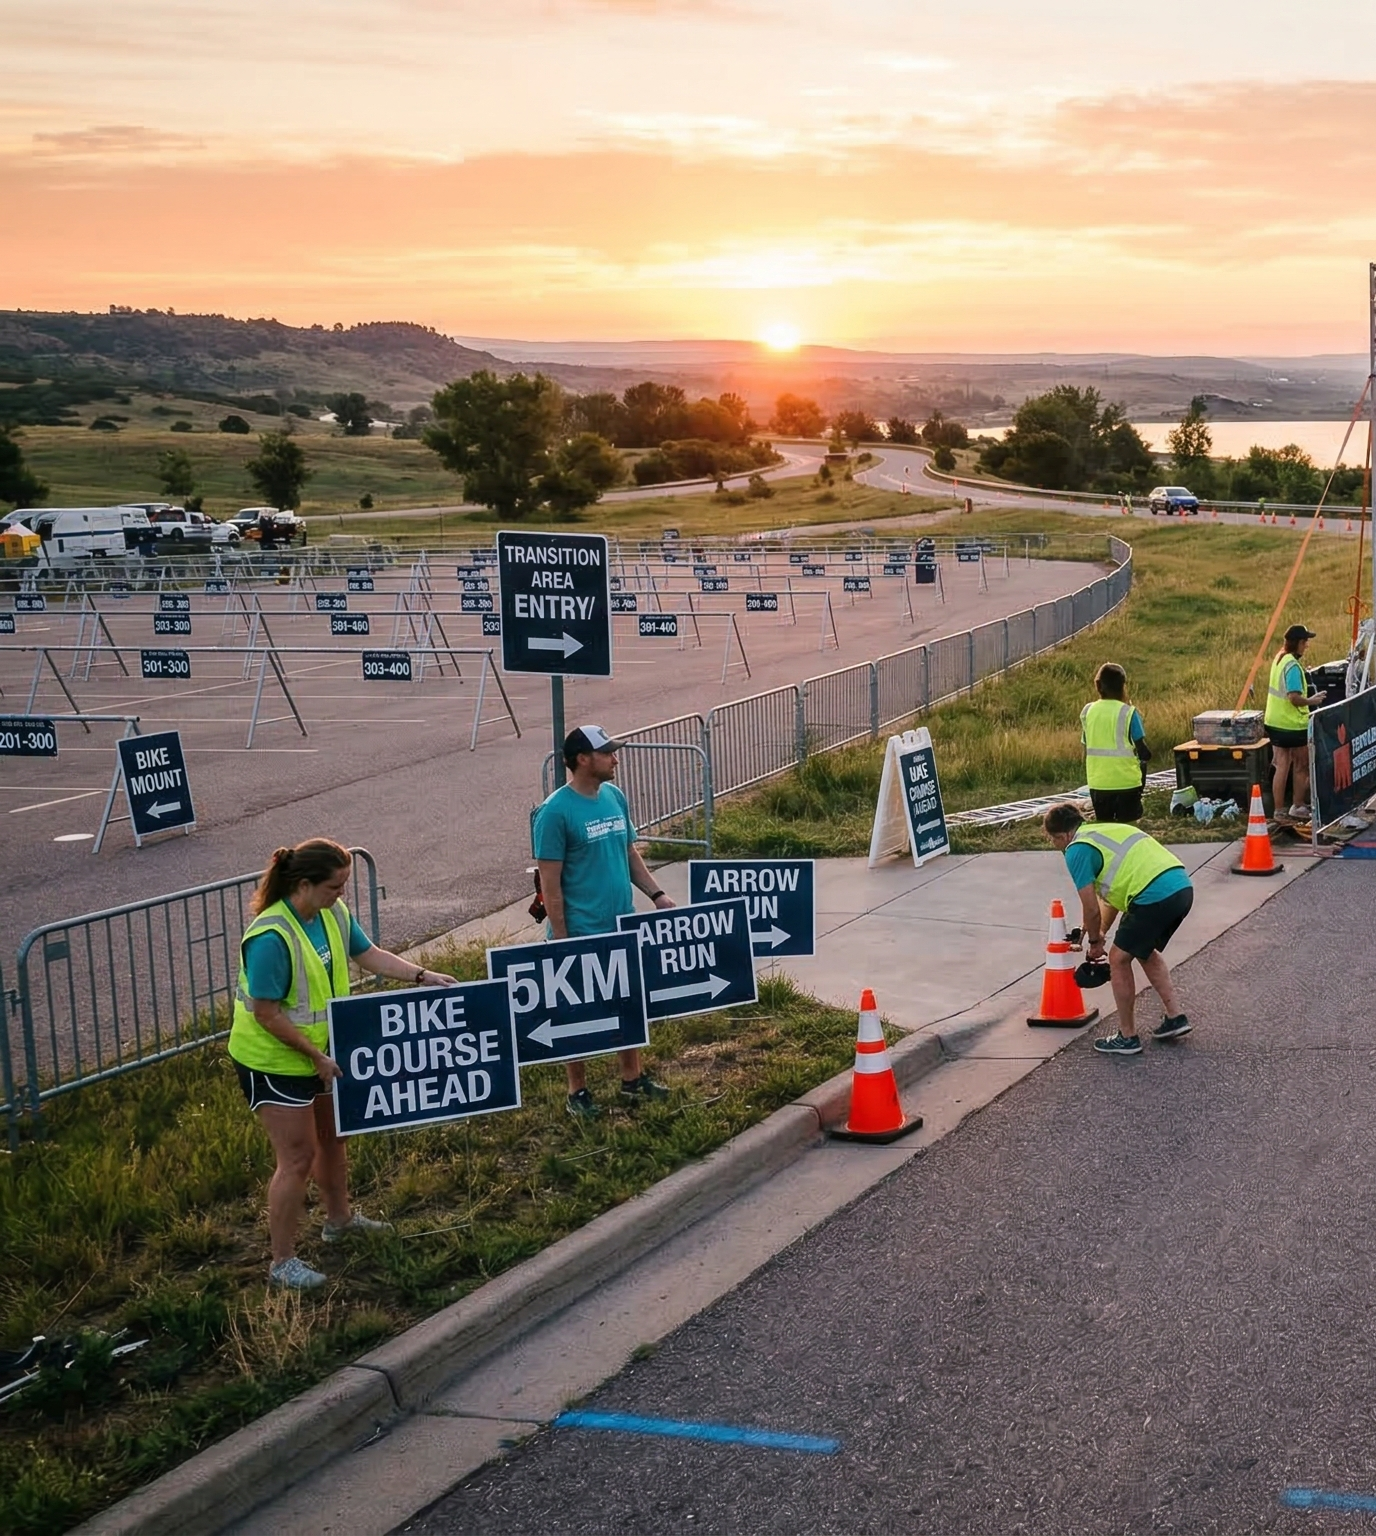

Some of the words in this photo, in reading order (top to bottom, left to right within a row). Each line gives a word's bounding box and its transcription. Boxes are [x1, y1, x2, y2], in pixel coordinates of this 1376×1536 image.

[504, 545, 600, 566] TRANSITION
[531, 571, 575, 590] AREA
[515, 594, 595, 620] ENTRY/
[364, 662, 410, 676] 303-400
[0, 732, 54, 749] 201-300
[135, 747, 171, 770] BIKE
[130, 768, 182, 795] MOUNT
[704, 868, 800, 893] ARROW
[748, 895, 778, 920] UN
[639, 909, 735, 948] ARROW
[660, 942, 717, 975] RUN
[513, 948, 631, 1014] 5KM
[380, 995, 468, 1038] BIKE
[350, 1029, 501, 1082] COURSE
[364, 1070, 492, 1120] AHEAD
